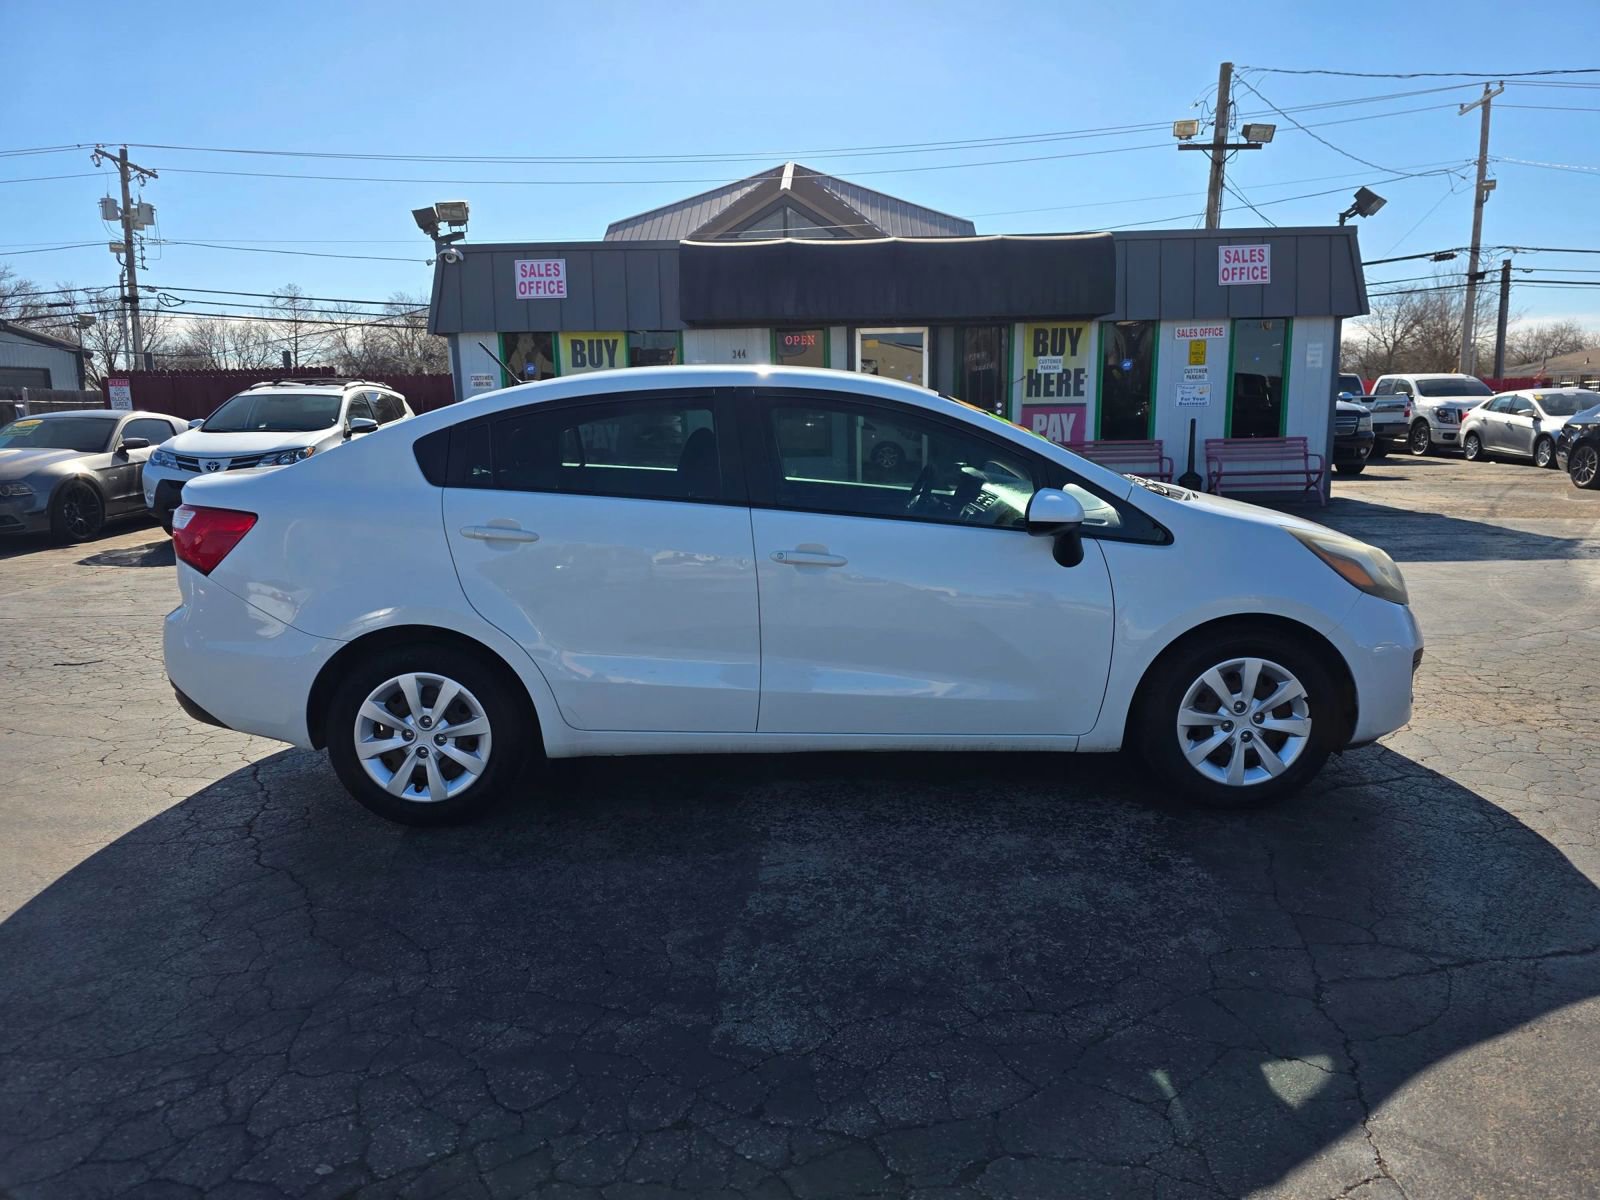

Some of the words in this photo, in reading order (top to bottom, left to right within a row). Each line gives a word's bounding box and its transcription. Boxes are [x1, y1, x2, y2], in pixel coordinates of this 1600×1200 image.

[1224, 248, 1265, 264] SALES
[520, 262, 560, 278] SALES
[1221, 265, 1268, 282] OFFICE
[518, 279, 564, 296] OFFICE
[785, 335, 815, 345] OPEN
[1177, 328, 1198, 338] SALES
[1199, 327, 1223, 337] OFFICE
[1032, 327, 1083, 358] BUY
[571, 339, 618, 368] BUY
[1026, 367, 1086, 398] HERE
[1032, 413, 1076, 442] PAY
